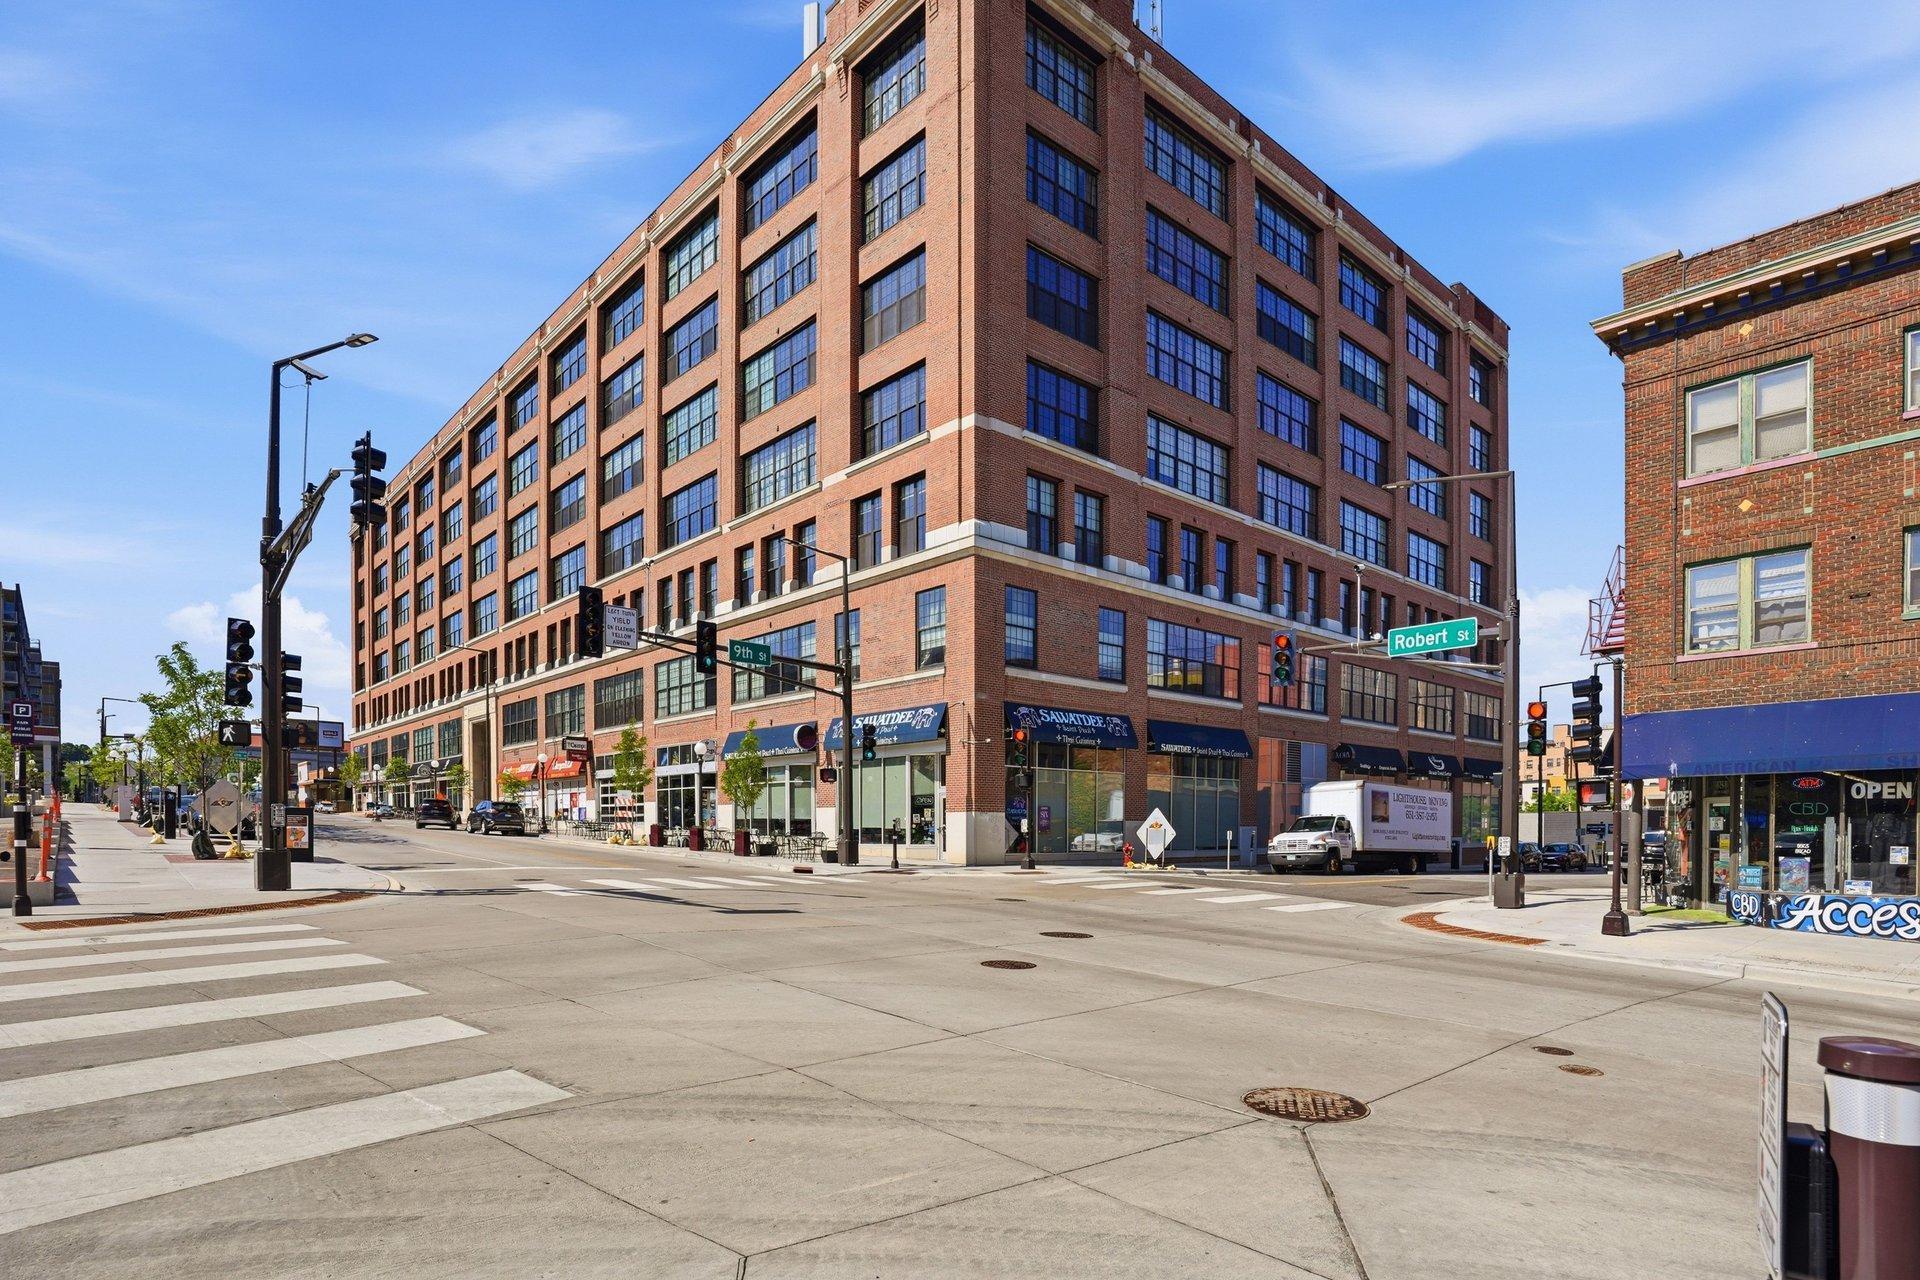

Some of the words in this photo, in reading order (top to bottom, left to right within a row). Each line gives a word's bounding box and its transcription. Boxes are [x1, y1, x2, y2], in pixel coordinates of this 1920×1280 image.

[612, 616, 630, 624] YIELD
[1395, 628, 1448, 650] Robert
[1457, 630, 1470, 641] St
[734, 645, 753, 659] 9th
[758, 652, 767, 661] St
[852, 711, 915, 729] SAWATDEE
[1039, 709, 1106, 728] SAWATDEE
[1160, 743, 1192, 754] SAWATDEE
[1693, 761, 1796, 775] AMERICAN
[1800, 779, 1820, 787] ATM
[1850, 781, 1912, 800] OPEN
[1393, 793, 1427, 805] LIGHTHOUSE
[1428, 796, 1448, 807] MOVING
[1789, 802, 1829, 816] CBD
[1732, 894, 1759, 916] CBD
